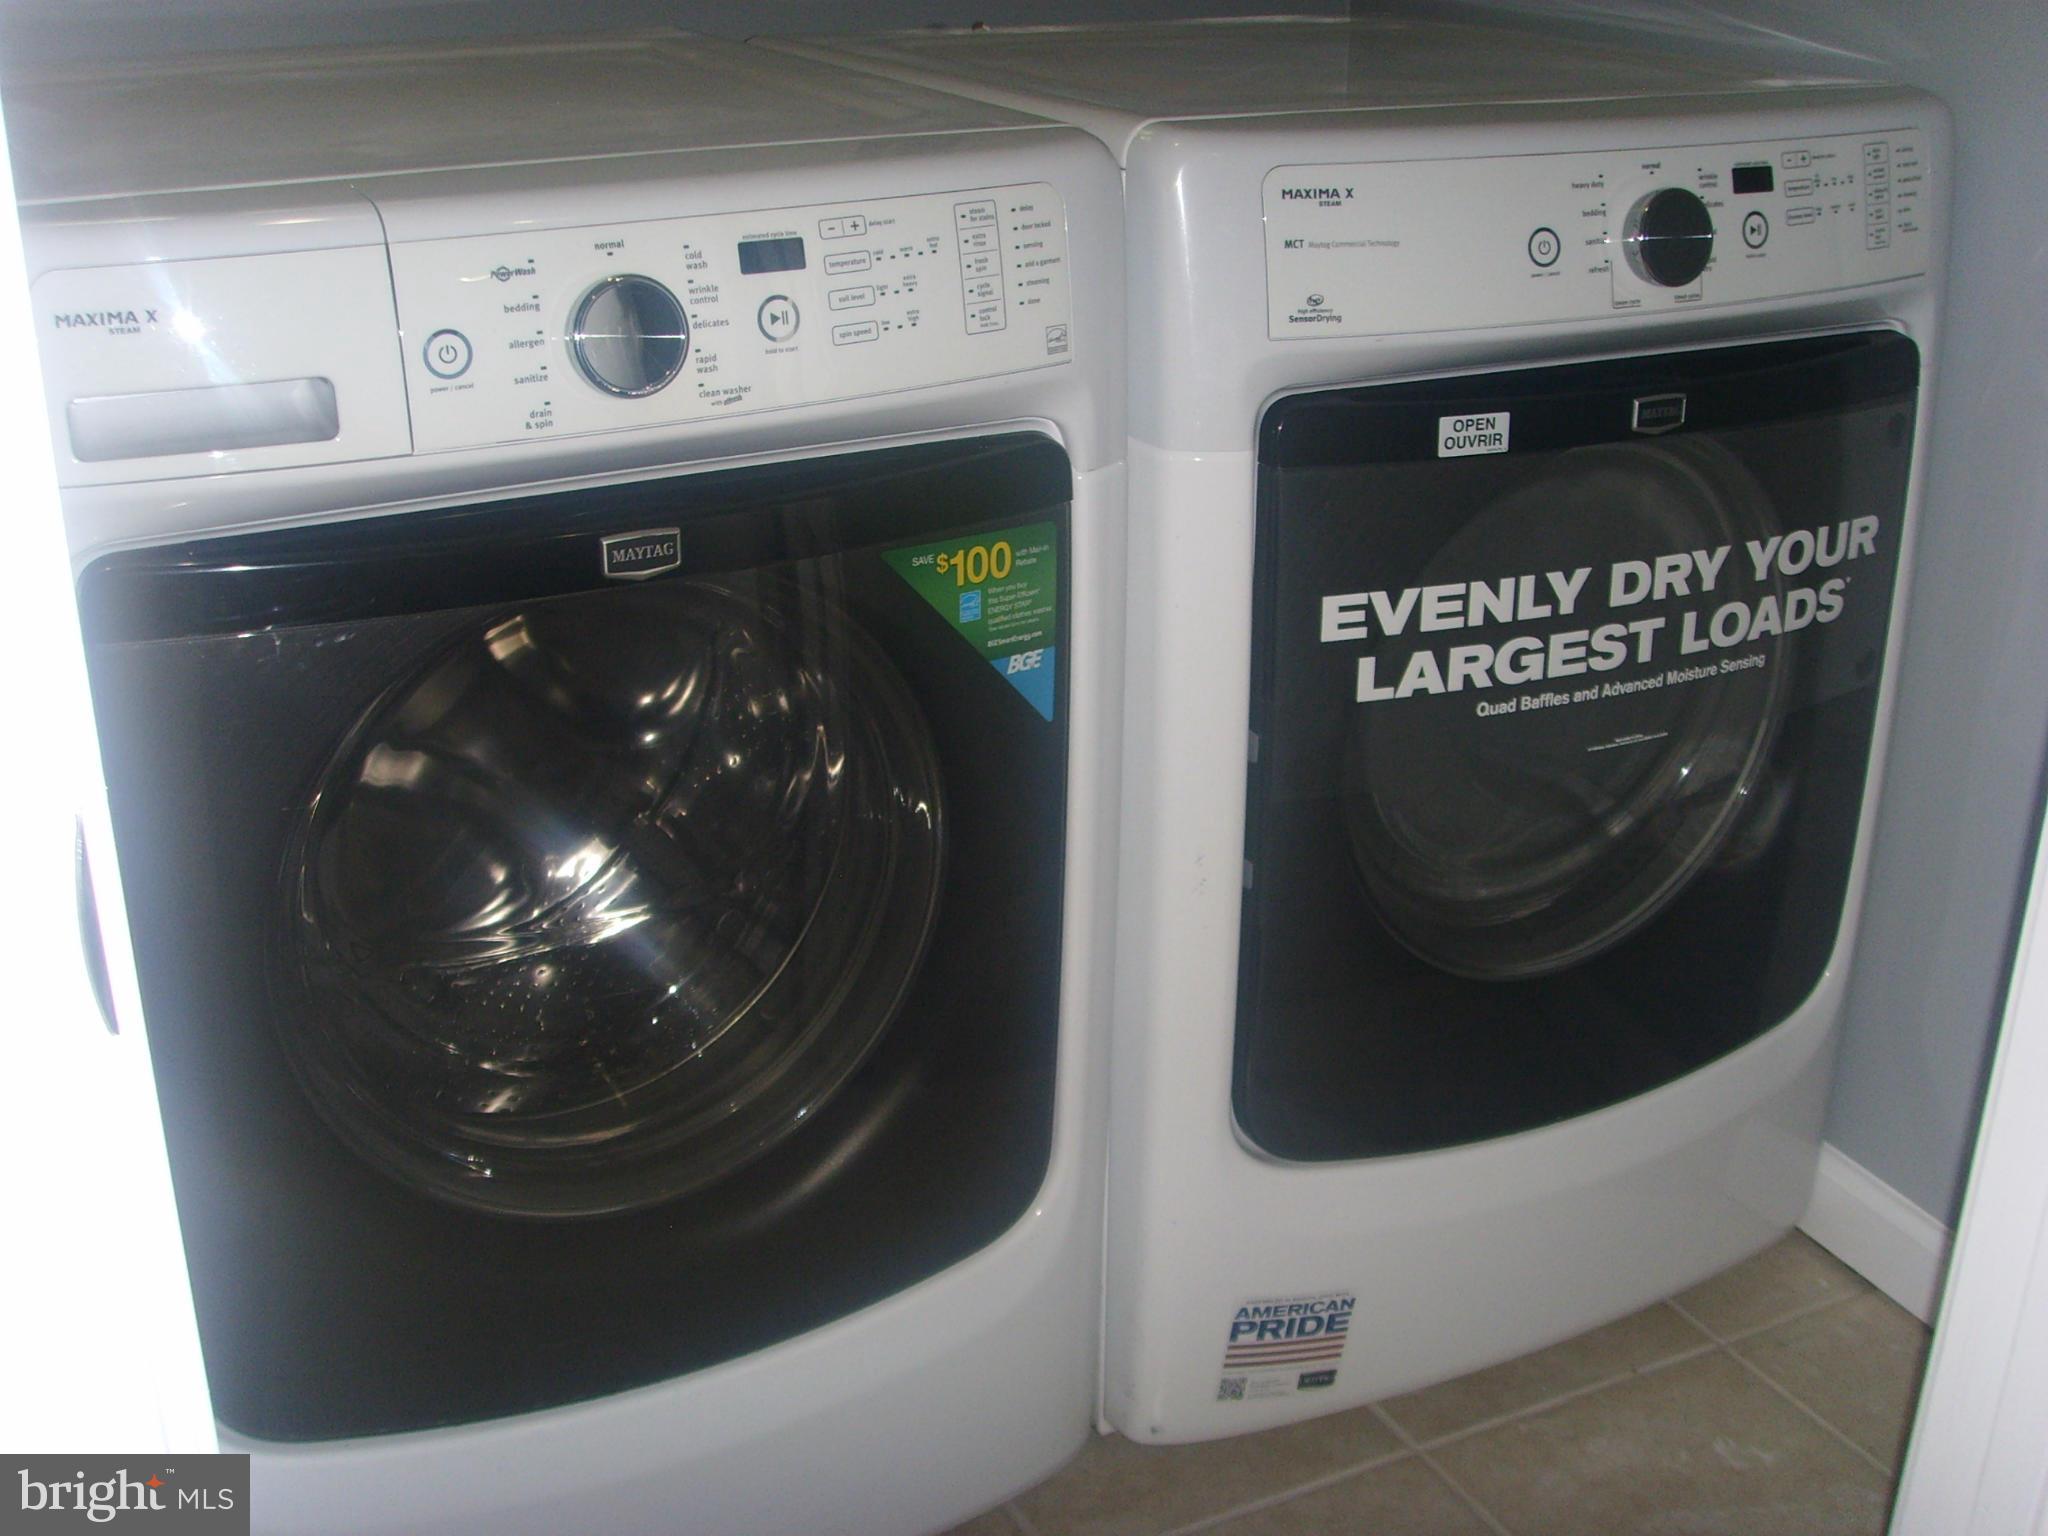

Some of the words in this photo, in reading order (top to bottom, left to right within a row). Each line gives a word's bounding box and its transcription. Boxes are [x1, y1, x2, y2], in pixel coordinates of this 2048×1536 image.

[1281, 188, 1340, 200] MAXIMA
[1345, 188, 1354, 199] X
[594, 239, 624, 251] normal
[1284, 239, 1304, 249] MCT
[1367, 240, 1400, 248] Technology
[685, 251, 703, 260] cold
[686, 260, 708, 271] wash
[688, 284, 719, 295] wrinkle
[690, 294, 719, 305] control
[504, 301, 541, 313] bedding
[54, 310, 139, 328] MAXIMA
[144, 309, 158, 324] X
[692, 318, 730, 329] delicates
[1288, 314, 1342, 323] SensorDrying
[108, 327, 142, 336] STEAM
[508, 337, 545, 349] allergen
[696, 354, 717, 365] rapid
[696, 364, 718, 374] wash
[514, 372, 549, 385] sanitize
[699, 388, 721, 398] clean
[722, 385, 752, 396] washer
[529, 409, 552, 419] drain
[525, 422, 533, 430] &
[534, 420, 554, 430] spin
[1453, 416, 1496, 433] OPEN
[1444, 432, 1504, 450] OUVRIR
[612, 542, 674, 564] MAYTAG
[912, 554, 934, 567] SAVE
[936, 541, 1012, 587] $100
[1320, 567, 1592, 643] EVENLY
[1609, 544, 1731, 608] DRY
[1746, 514, 1880, 582] YOUR
[1007, 648, 1044, 675] BGE
[1356, 618, 1665, 703] LARGEST
[1476, 696, 1517, 718] Quad
[1520, 692, 1570, 712] Baffles
[1573, 685, 1599, 702] and
[1601, 676, 1664, 698] Advanced
[1666, 665, 1718, 686] Moisture
[1720, 654, 1766, 675] Sensing
[1234, 1297, 1356, 1320] AMERICAN
[1229, 1311, 1353, 1343] PRIDE
